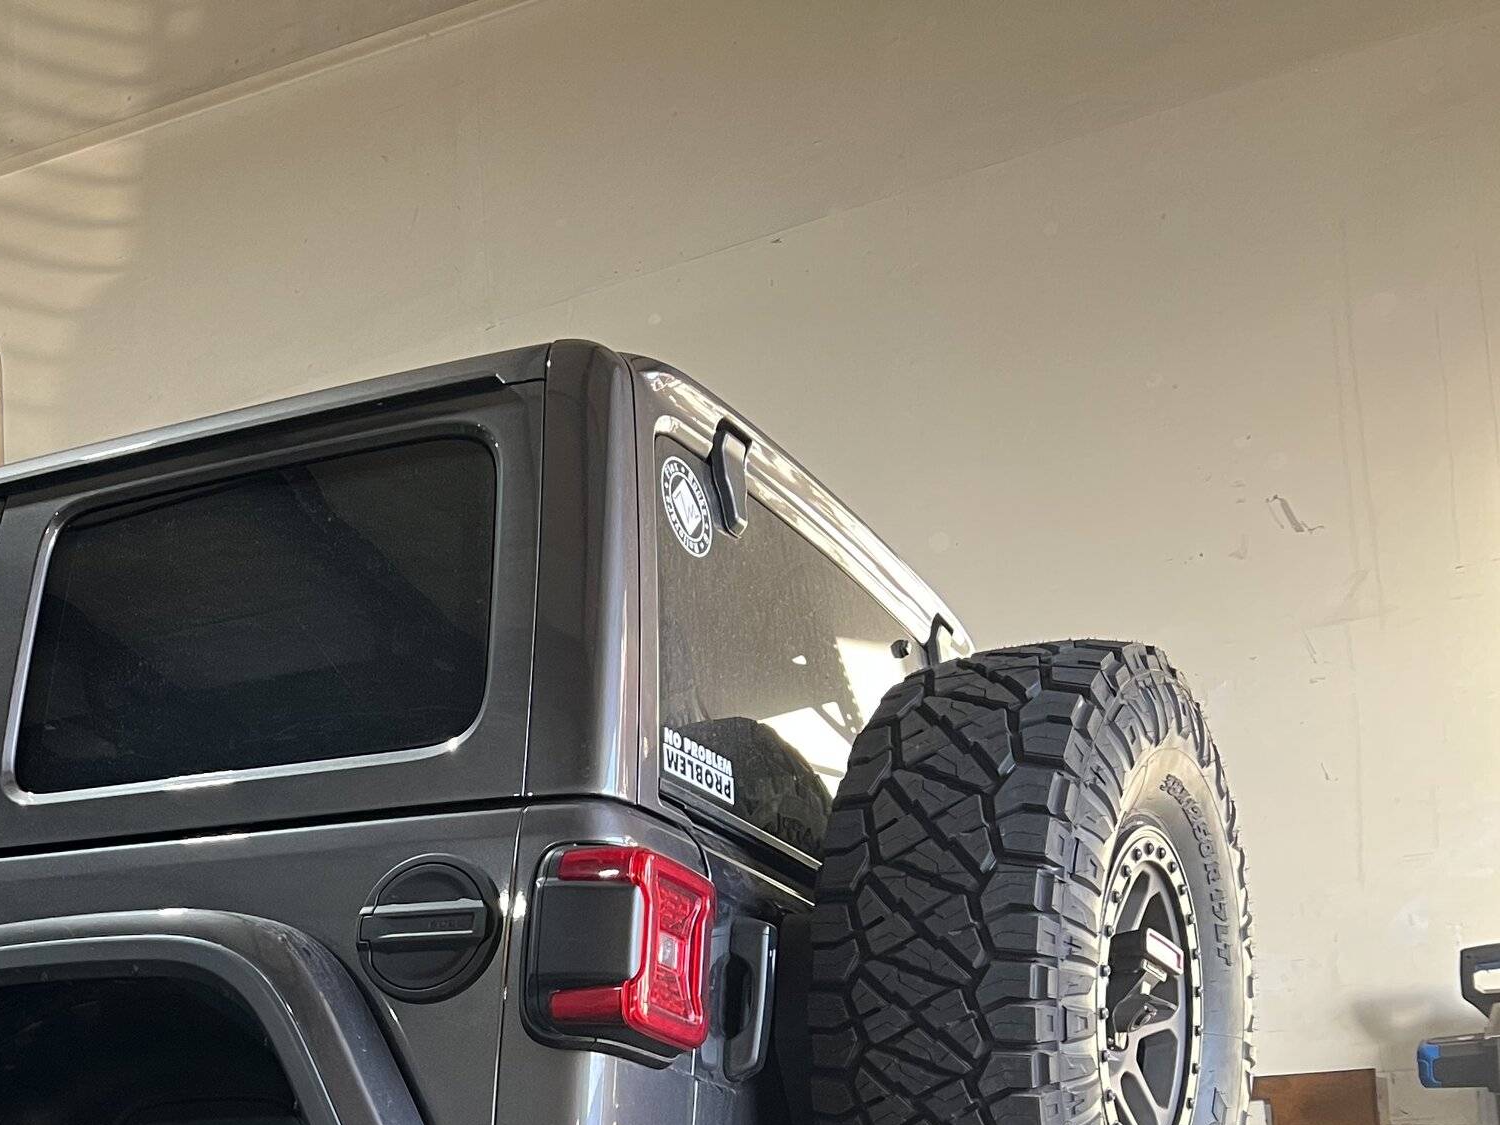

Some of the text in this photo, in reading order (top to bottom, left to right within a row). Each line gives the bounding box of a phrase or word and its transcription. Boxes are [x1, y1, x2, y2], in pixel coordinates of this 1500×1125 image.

[664, 726, 733, 777] NO PROBLEM
[666, 747, 731, 800] PROBLEM
